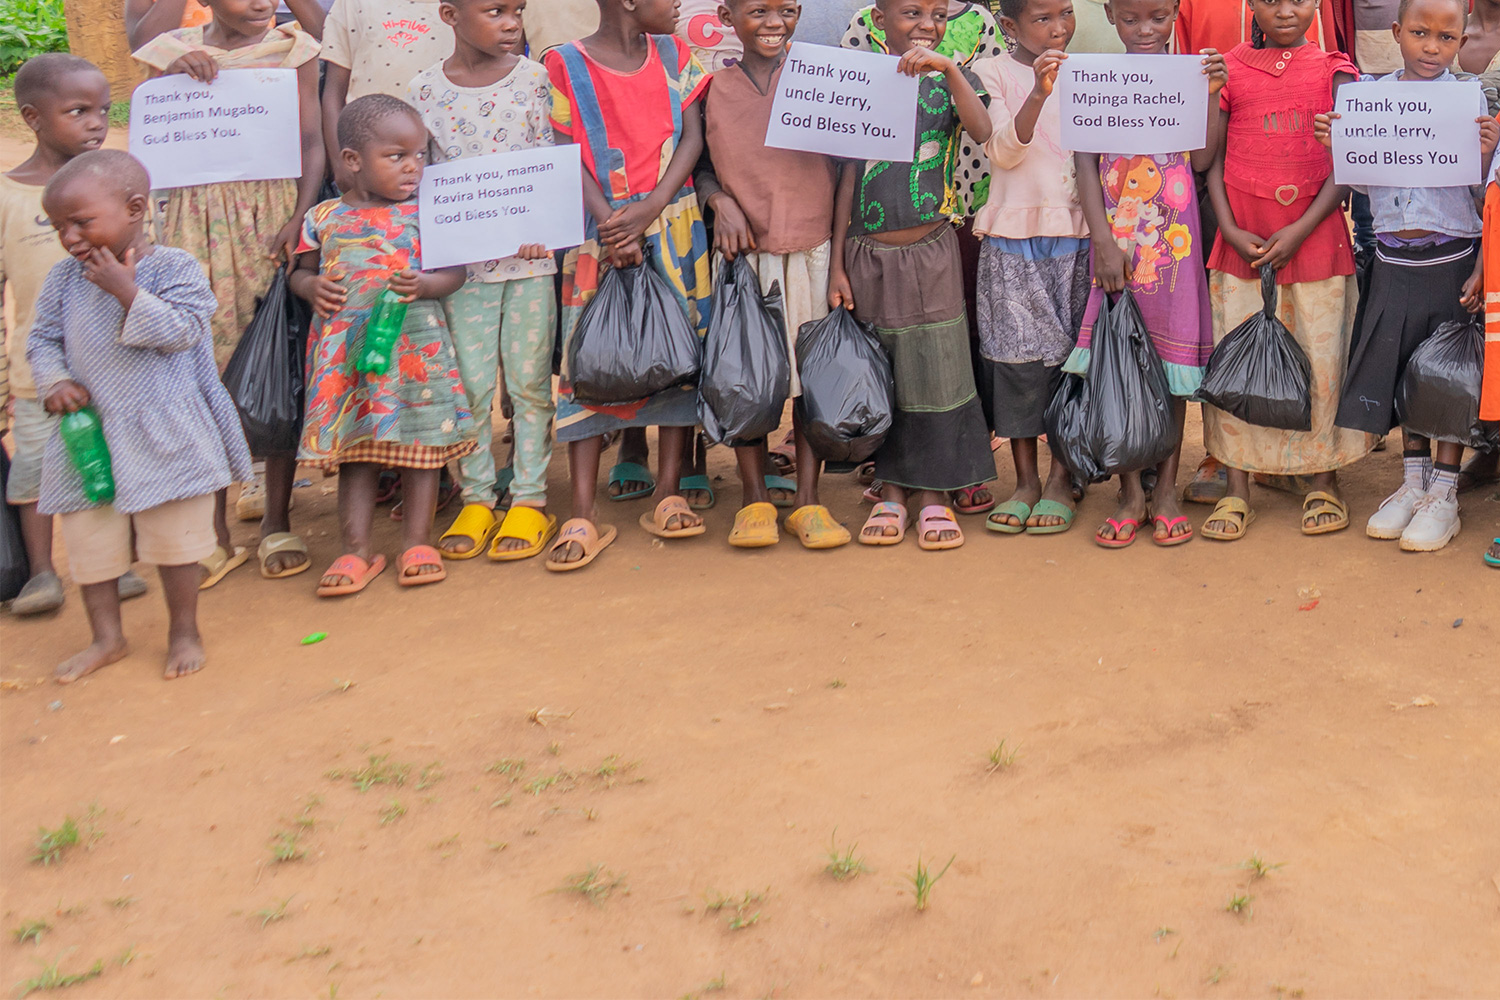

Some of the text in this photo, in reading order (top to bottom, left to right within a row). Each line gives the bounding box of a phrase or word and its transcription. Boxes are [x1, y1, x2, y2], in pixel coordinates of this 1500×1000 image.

[790, 59, 870, 85] Thank you,
[1072, 70, 1153, 85] Thank you,
[145, 90, 214, 105] Thank you,
[785, 88, 871, 111] uncle Jerry,
[1073, 92, 1185, 107] Mpinga Rachel,
[1346, 98, 1432, 115] Thank you,
[144, 104, 269, 124] Benjamin Mugabo,
[1073, 115, 1180, 127] God Bless You.
[781, 112, 896, 138] God Bless You.
[1345, 124, 1436, 140] uncle Jerry,
[143, 127, 241, 145] God Bless You.
[1346, 151, 1458, 165] God Bless You
[433, 162, 554, 187] Thank you, maman
[433, 184, 534, 205] Kavira Hosanna
[434, 211, 461, 225] God
[501, 204, 530, 216] You.
